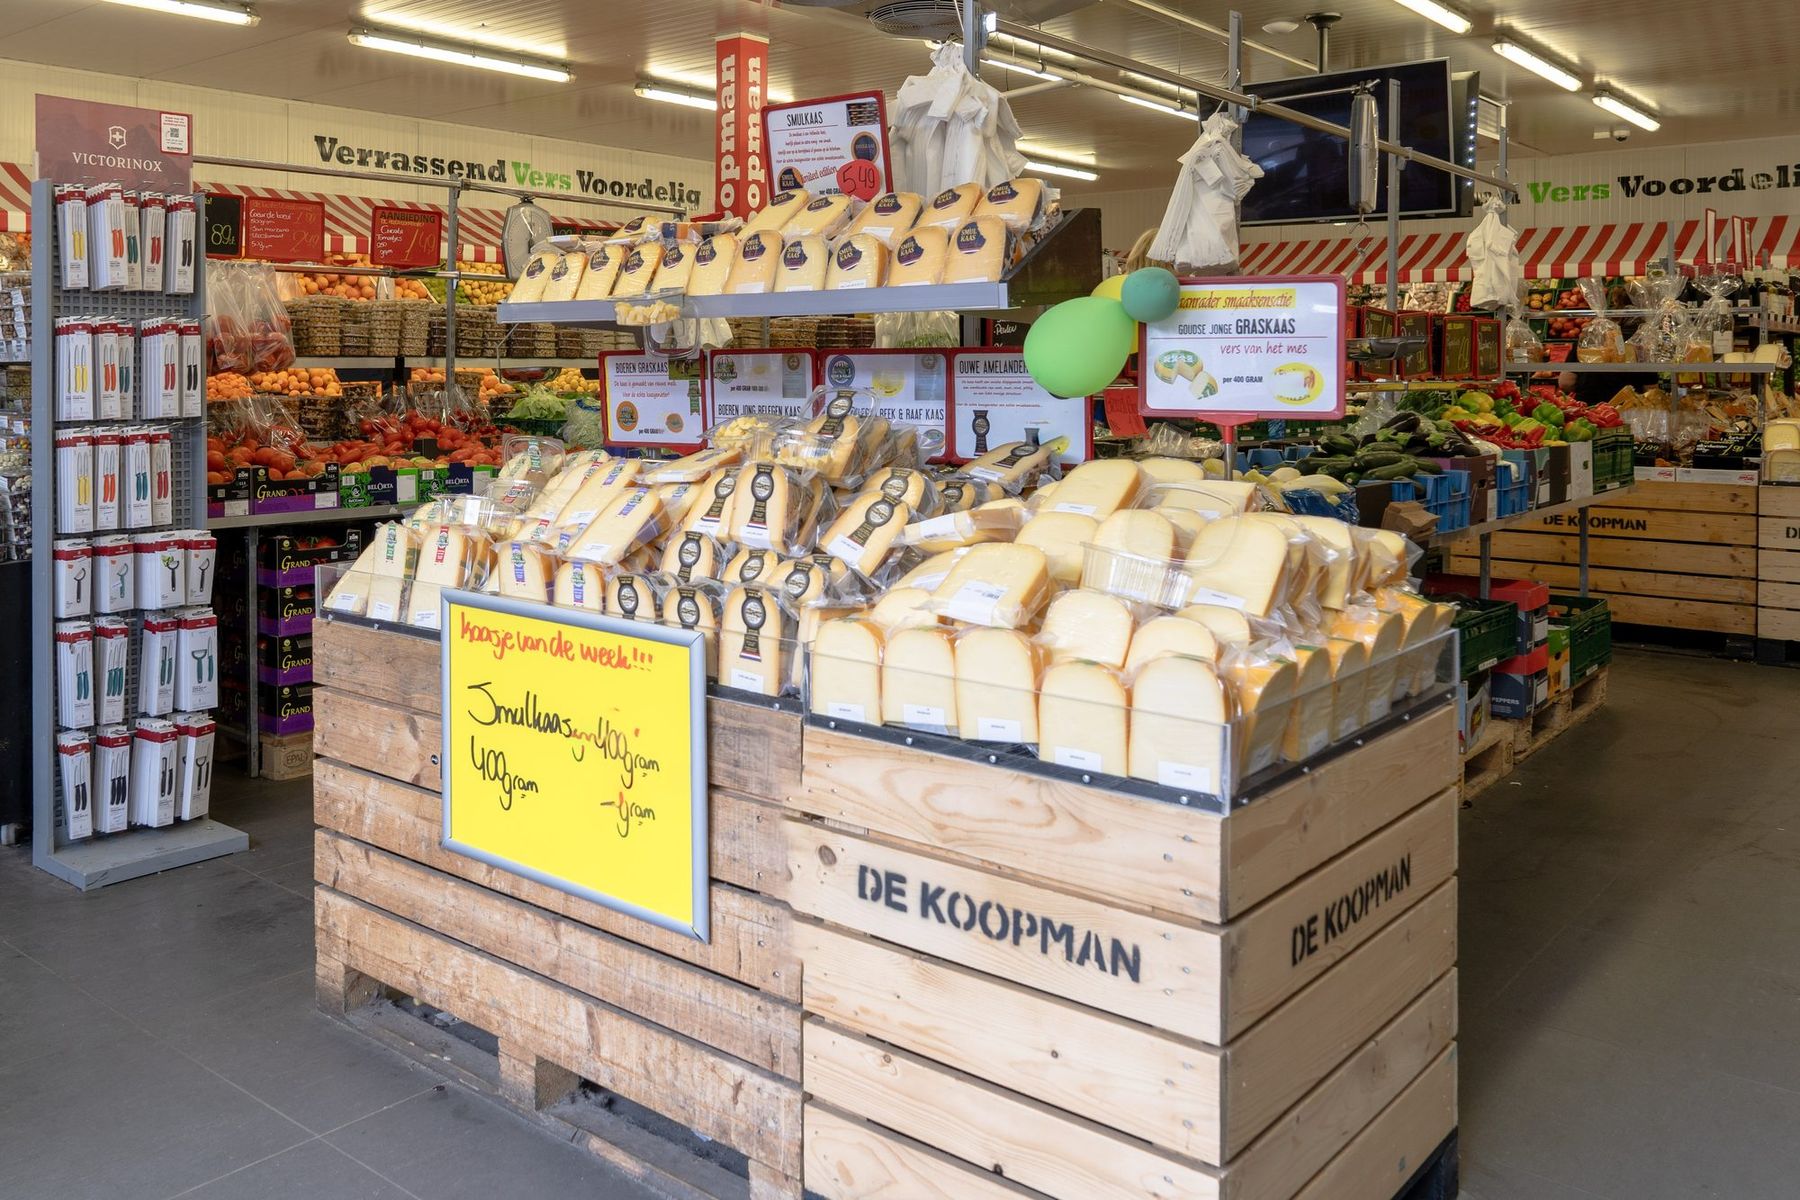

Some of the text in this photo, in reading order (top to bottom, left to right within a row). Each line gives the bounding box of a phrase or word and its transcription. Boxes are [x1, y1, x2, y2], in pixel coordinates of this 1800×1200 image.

[786, 111, 823, 126] SMULKAAS
[72, 152, 162, 172] VICTORINOX
[314, 134, 507, 183] Verrassend
[511, 160, 572, 190] Vers
[1527, 181, 1611, 204] Vers
[380, 211, 435, 223] AANBIEDING
[1223, 290, 1292, 310] smaaksensatie
[1178, 318, 1296, 335] GOUDSE JONGE GRASKAAS
[1220, 341, 1307, 354] vers van het mes
[616, 362, 668, 373] BOEREN GRASKAAS
[960, 360, 980, 374] OUWE
[718, 404, 739, 416] BOEREN
[785, 405, 800, 416] KAAS
[898, 409, 903, 419] &
[906, 408, 923, 420] RAAF
[926, 408, 944, 420] KAAS
[257, 484, 287, 503] GRAND
[1544, 515, 1647, 530] DE KOPMAN
[281, 555, 310, 575] GRAND
[283, 603, 312, 622] GRAND
[282, 654, 311, 673] GRAND
[281, 702, 311, 722] GRAND
[1292, 852, 1410, 967] DE KOOPMAN
[858, 864, 1141, 983] DE KOOPMAN
